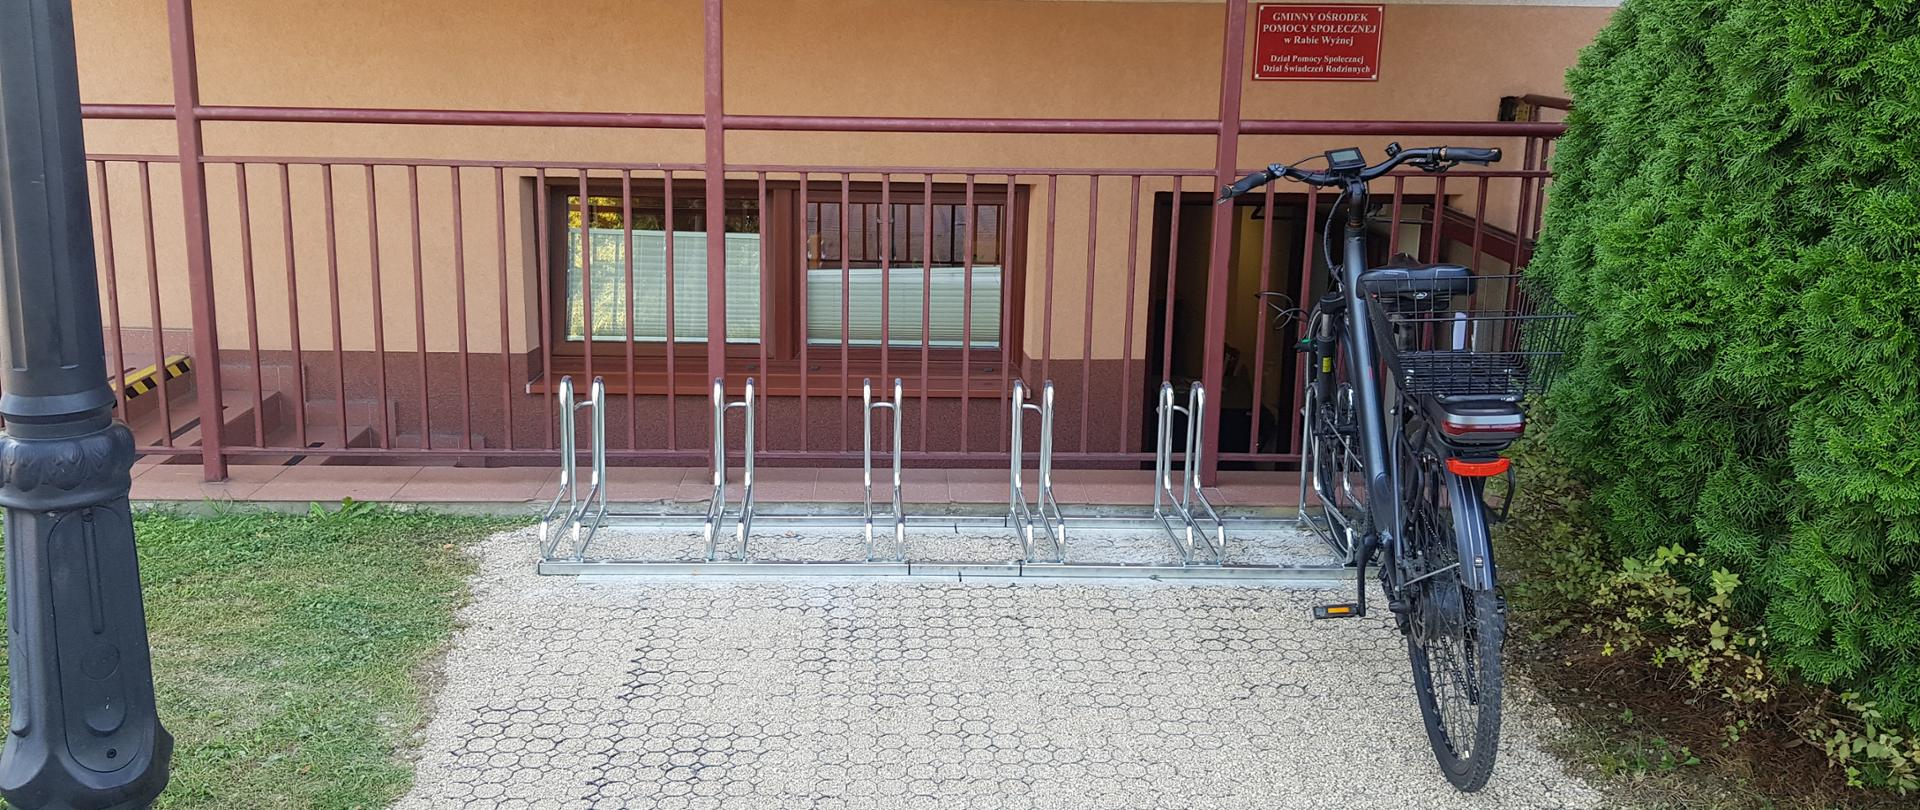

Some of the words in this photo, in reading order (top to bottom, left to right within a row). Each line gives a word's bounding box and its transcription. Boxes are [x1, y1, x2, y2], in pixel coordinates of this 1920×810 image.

[1272, 12, 1316, 21] GMINNY
[1317, 11, 1368, 22] OŚRODEK
[1263, 24, 1310, 33] POMOCY
[1310, 24, 1377, 33] SPOŁECZNEJ
[1294, 35, 1319, 44] Rabie
[1321, 36, 1354, 46] Wyżnej
[1292, 55, 1322, 64] Pomocy
[1283, 63, 1324, 73] Świadczeń
[1325, 65, 1370, 73] Rodzinnych
